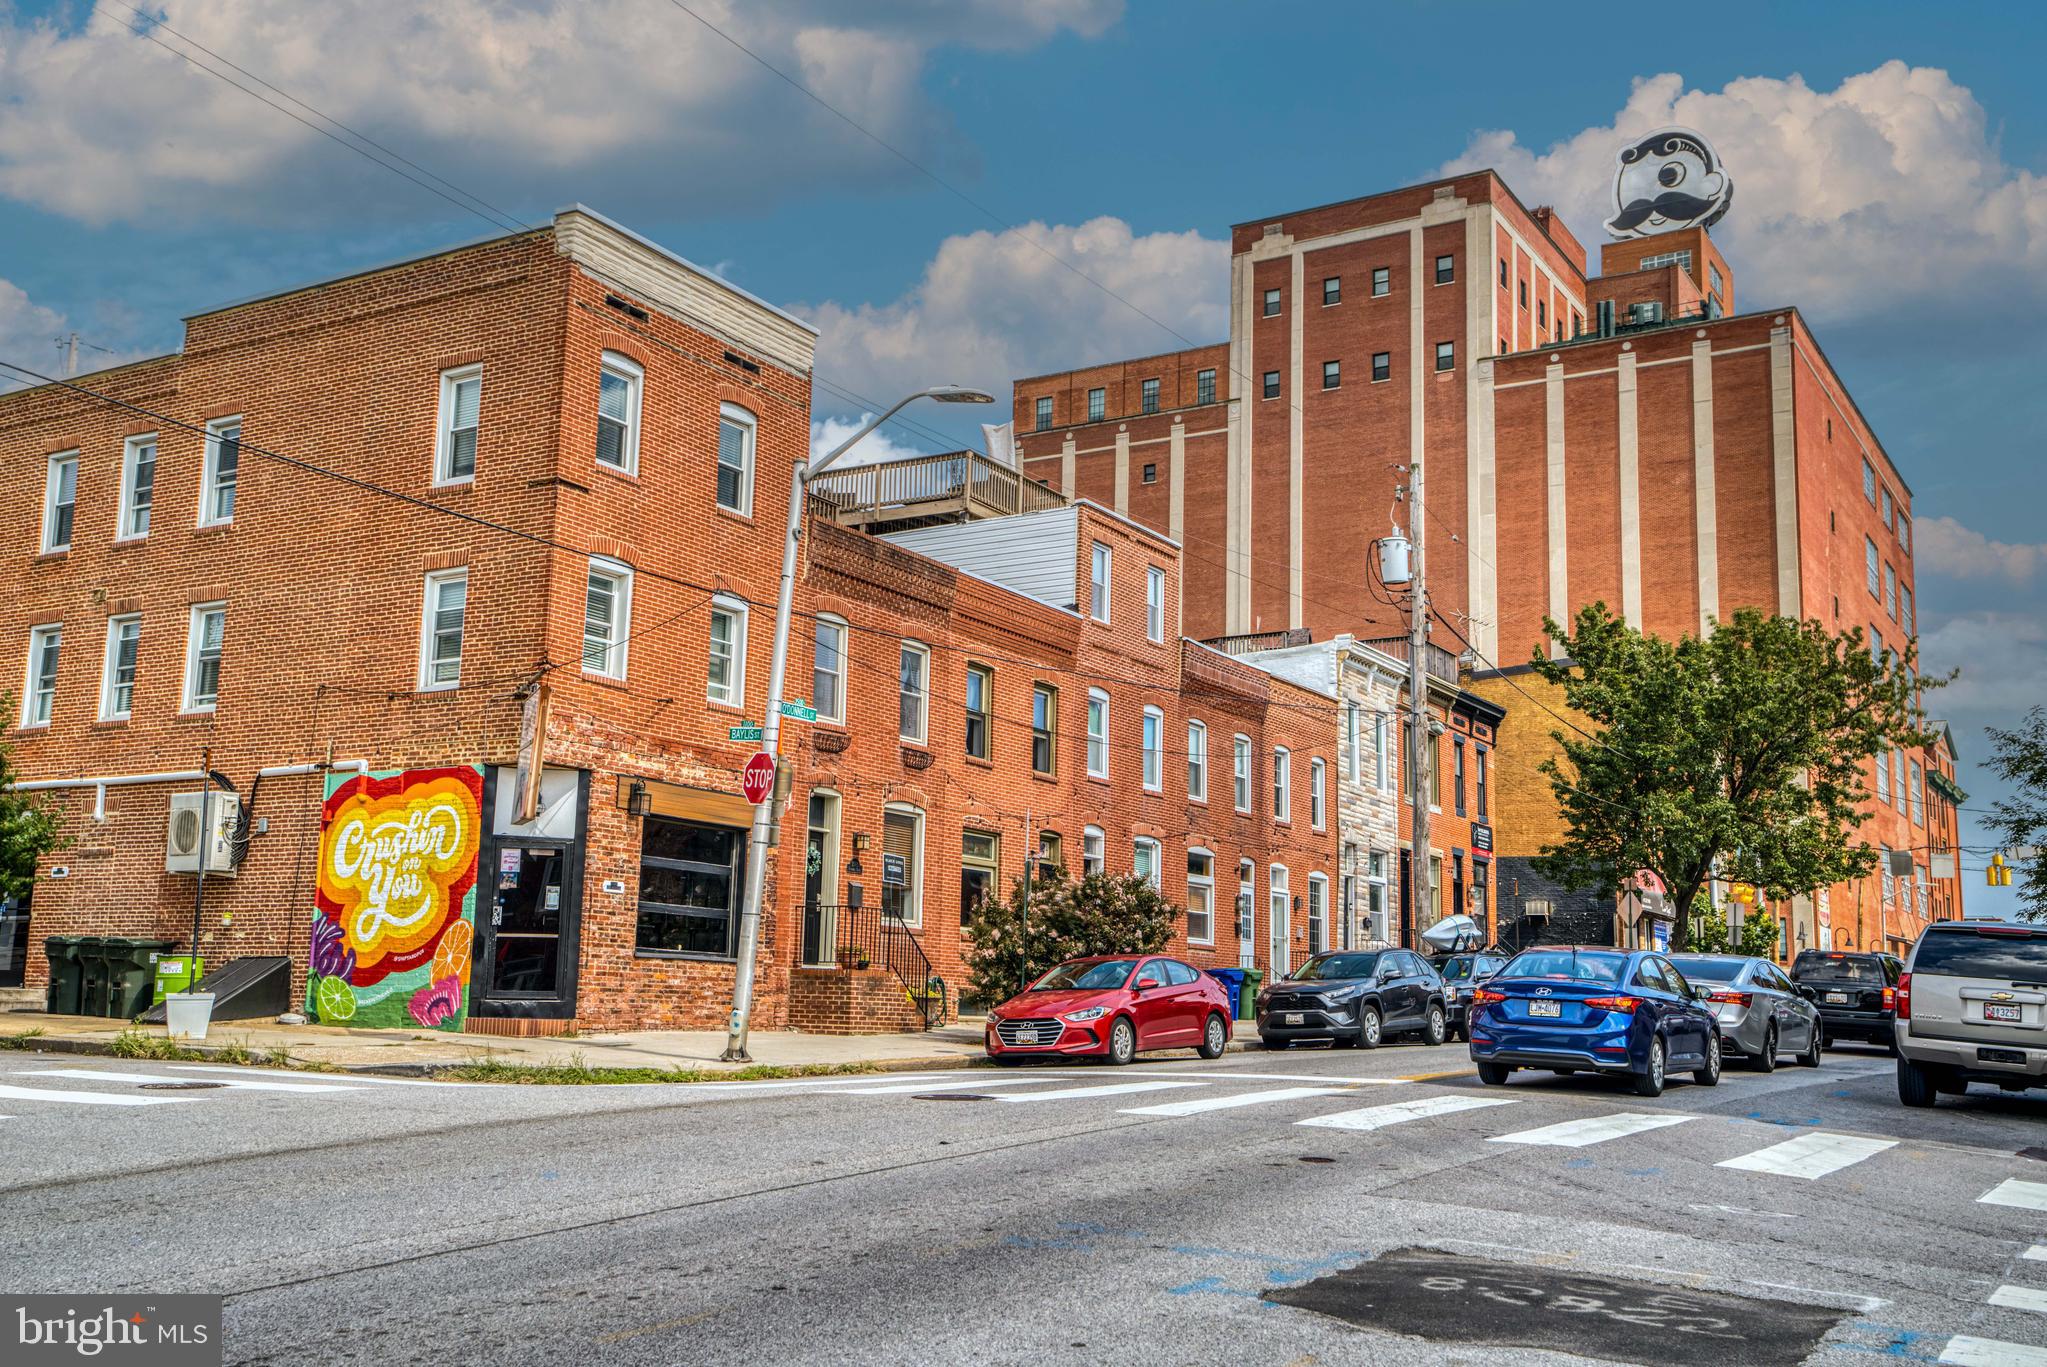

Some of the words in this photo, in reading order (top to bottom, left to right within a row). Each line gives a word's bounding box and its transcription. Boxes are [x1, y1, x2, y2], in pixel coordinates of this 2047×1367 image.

[782, 702, 809, 719] O'DONNELL
[731, 729, 754, 739] BAYLIS
[745, 768, 773, 789] STOP
[334, 804, 461, 881] Crushin
[402, 857, 421, 873] on
[356, 862, 431, 942] You
